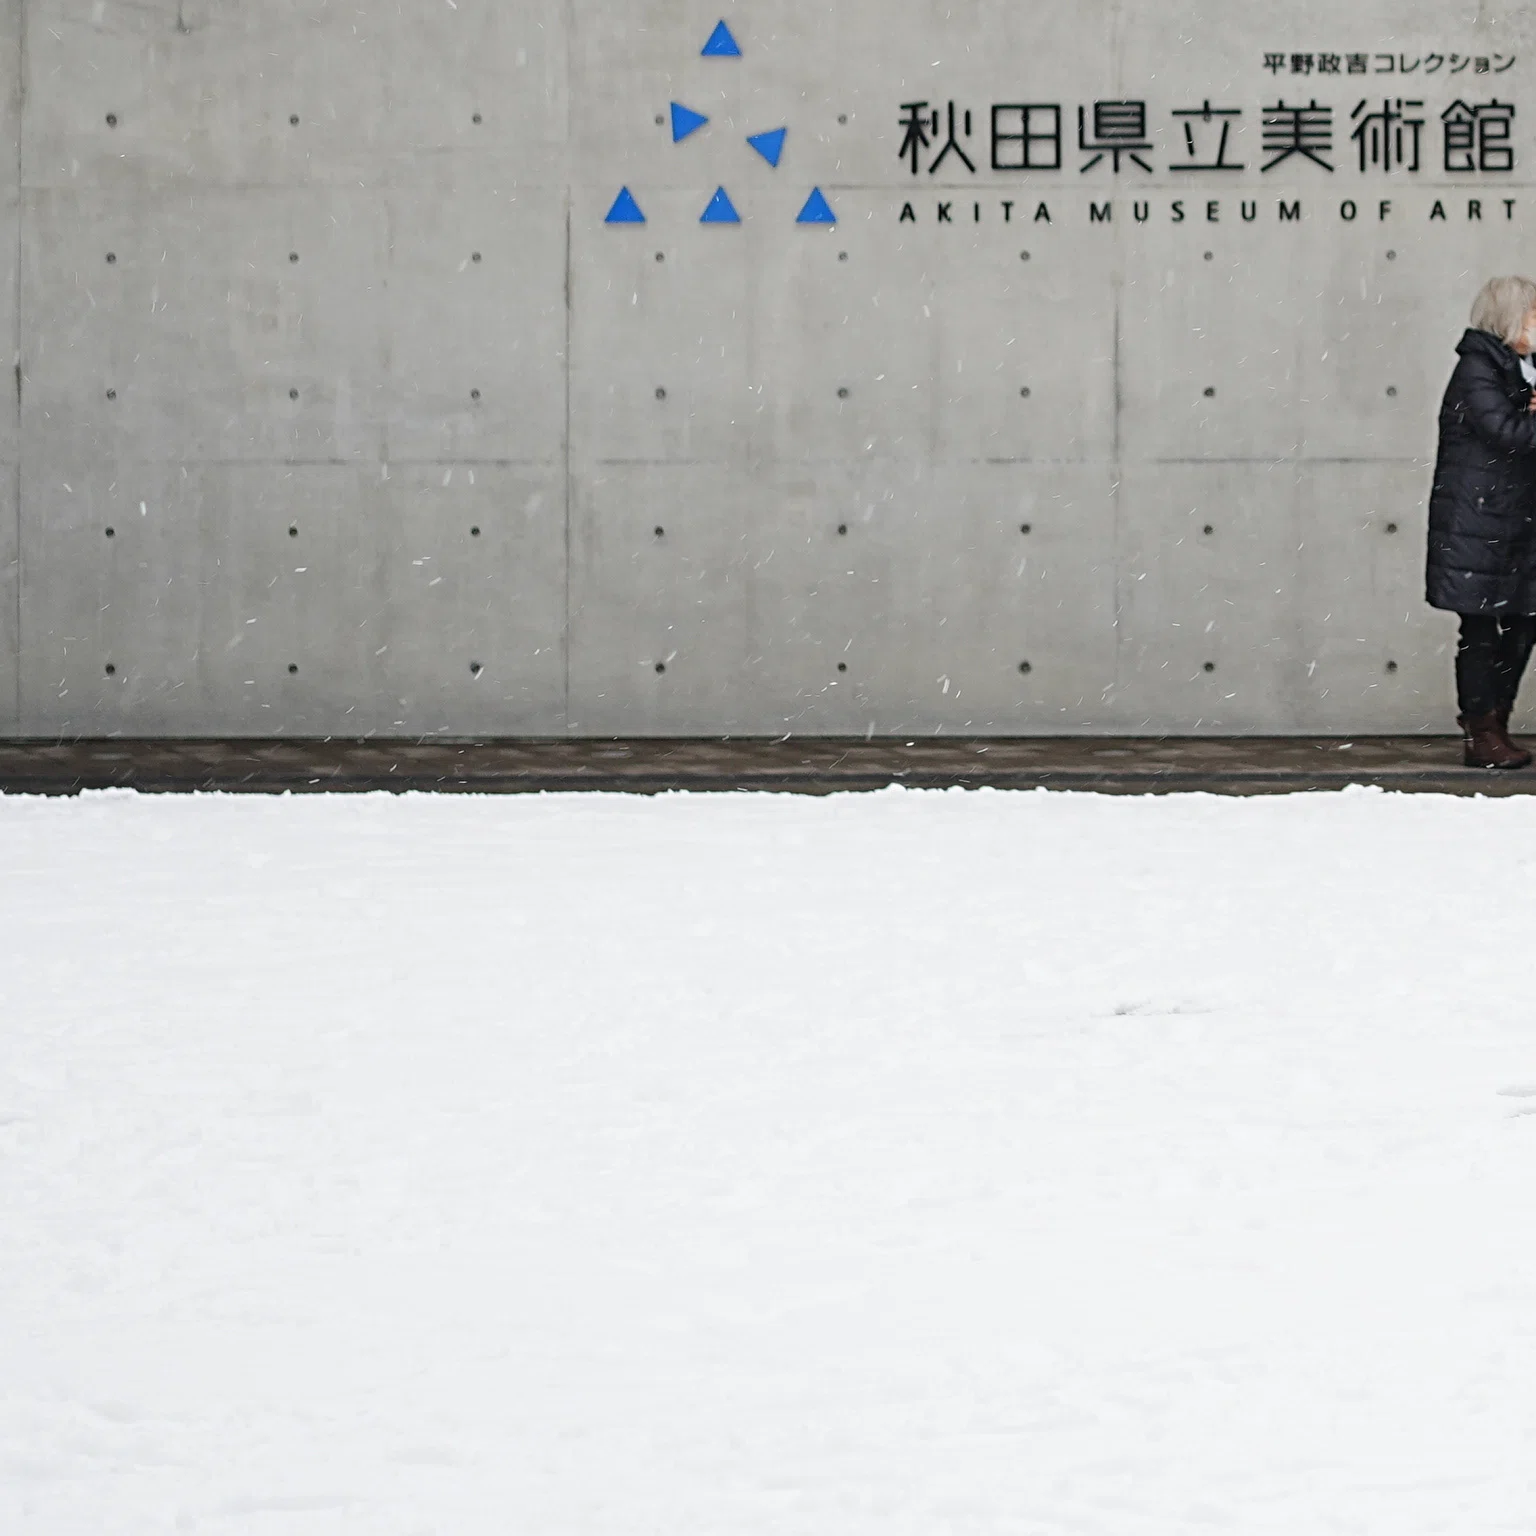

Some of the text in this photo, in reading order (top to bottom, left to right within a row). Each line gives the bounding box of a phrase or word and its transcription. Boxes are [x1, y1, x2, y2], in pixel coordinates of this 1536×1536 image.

[1264, 53, 1515, 75] 平野政吉コレクション
[899, 98, 1515, 175] 秋田県立美術館
[900, 200, 1515, 223] AKITA MUSEUM OF ART
